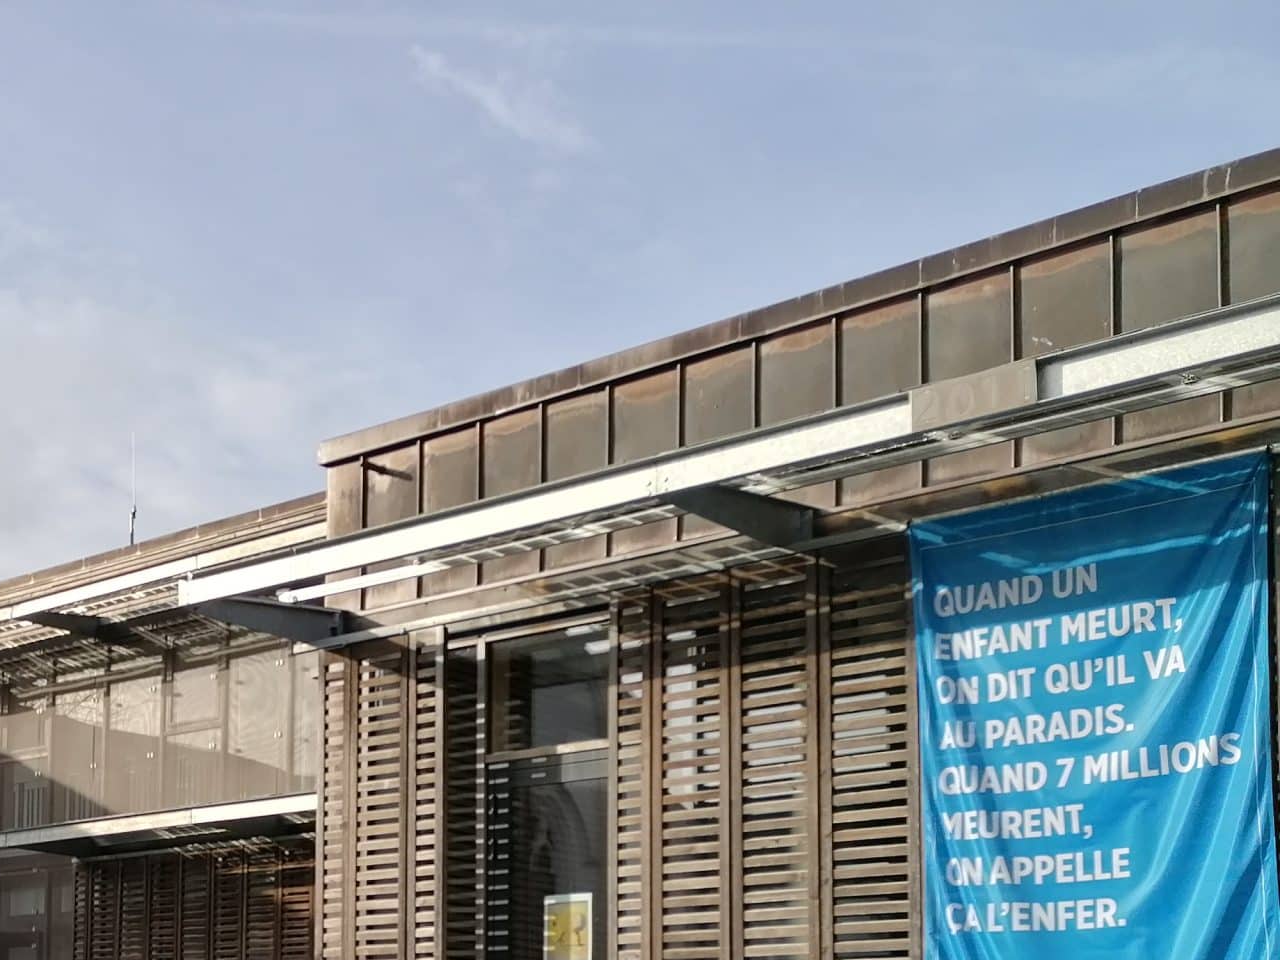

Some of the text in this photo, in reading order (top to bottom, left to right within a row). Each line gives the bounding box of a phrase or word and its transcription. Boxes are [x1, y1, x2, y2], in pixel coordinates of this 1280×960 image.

[934, 563, 1097, 618] QUAND UN
[935, 598, 1183, 661] ENFANT MEURT,
[937, 645, 1186, 705] ON DIT QU’IL VA
[939, 703, 1135, 750] AU PARADIS.
[938, 733, 1241, 795] QUAND 7 MILLIONS
[942, 804, 1093, 840] MEURENT,
[947, 848, 1131, 886] ON APPELLE
[945, 898, 1127, 935] ÇA L’ENFER.
